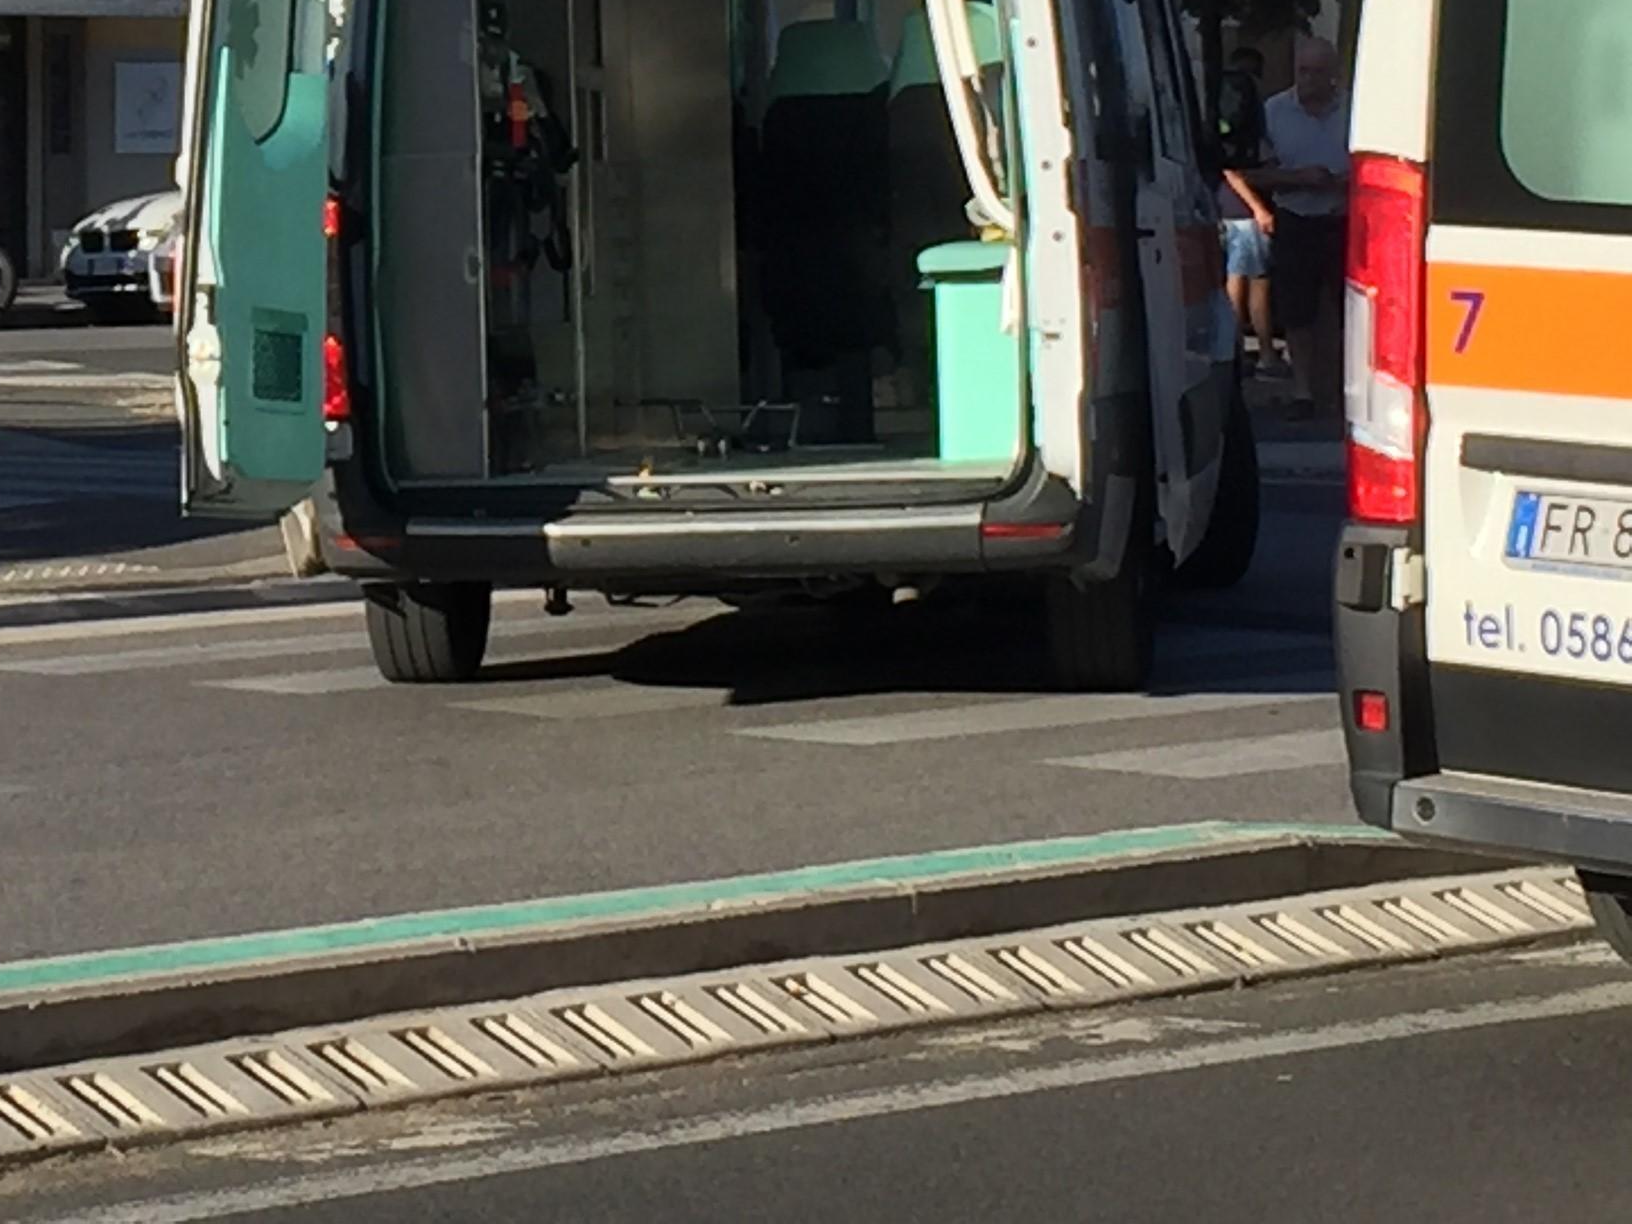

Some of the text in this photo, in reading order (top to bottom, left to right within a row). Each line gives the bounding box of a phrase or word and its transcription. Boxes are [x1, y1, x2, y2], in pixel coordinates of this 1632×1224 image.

[1450, 290, 1486, 354] 7
[1540, 502, 1597, 557] FR
[1463, 601, 1632, 665] tel. 0586
